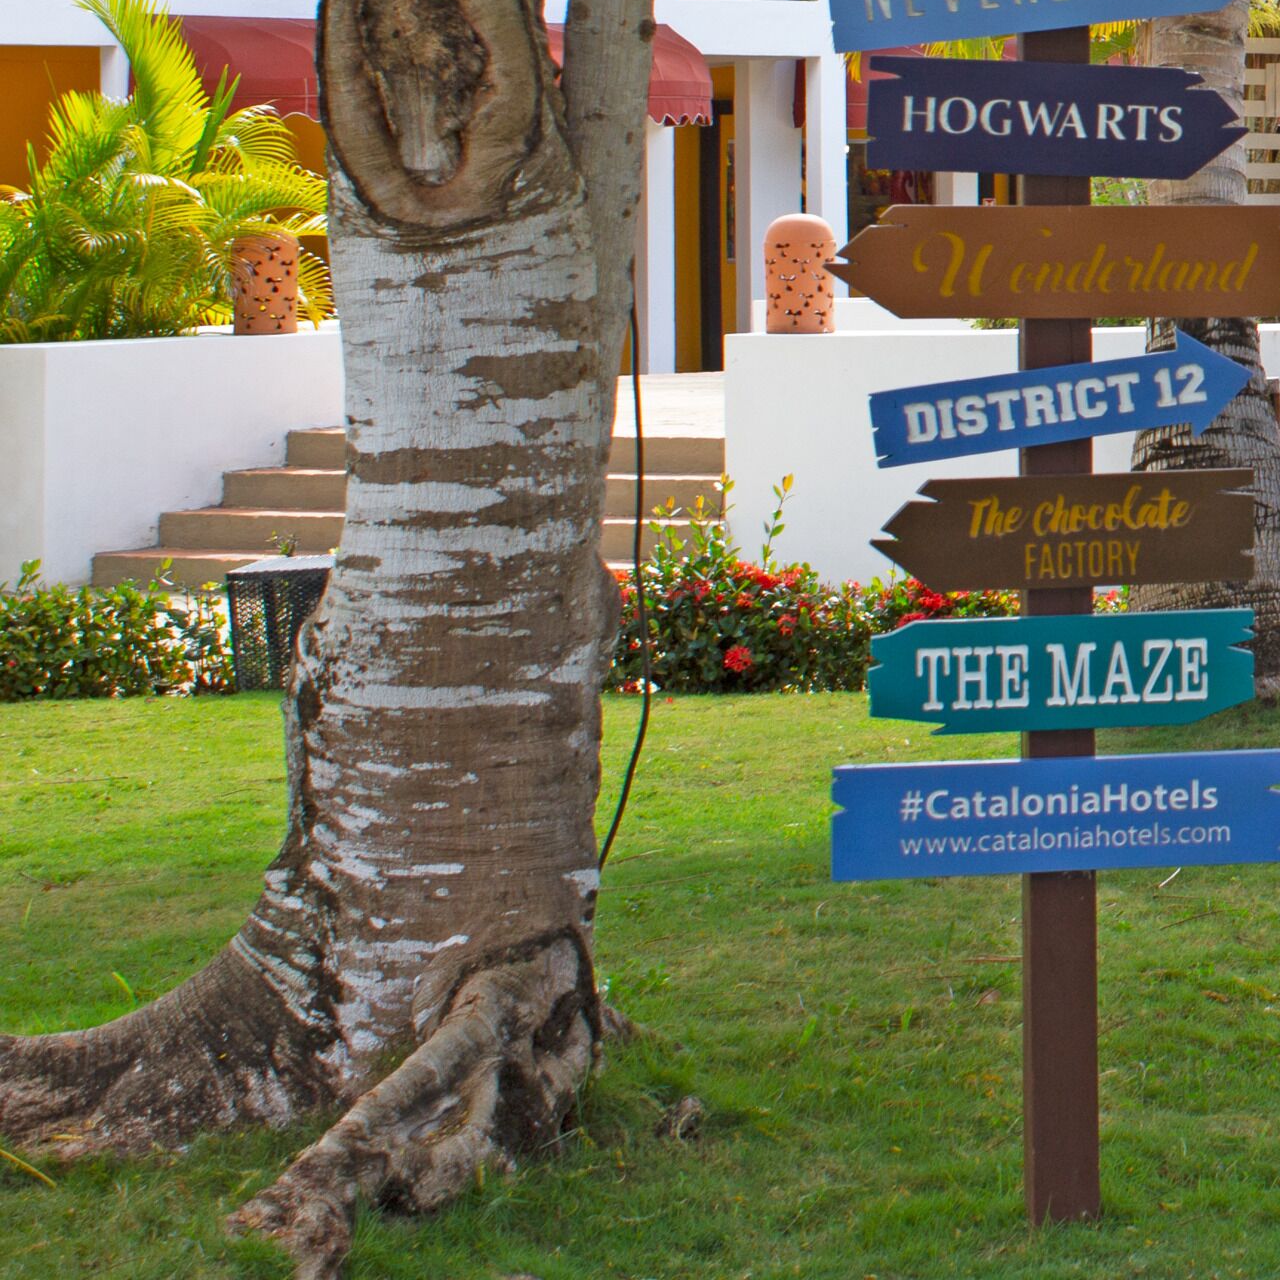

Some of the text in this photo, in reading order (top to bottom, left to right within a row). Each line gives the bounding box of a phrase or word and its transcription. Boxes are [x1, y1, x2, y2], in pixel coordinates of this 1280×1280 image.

[902, 95, 1183, 143] HOGWARTS
[912, 227, 1260, 298] Wonderland
[903, 363, 1208, 445] DISTRICT 12
[968, 485, 1195, 538] The Chocolate
[1025, 540, 1141, 580] FACTORY
[916, 638, 1209, 712] THE MAZE
[899, 779, 1219, 822] #CataloniaHotels
[900, 822, 1231, 856] www.cataloniahotels.com
